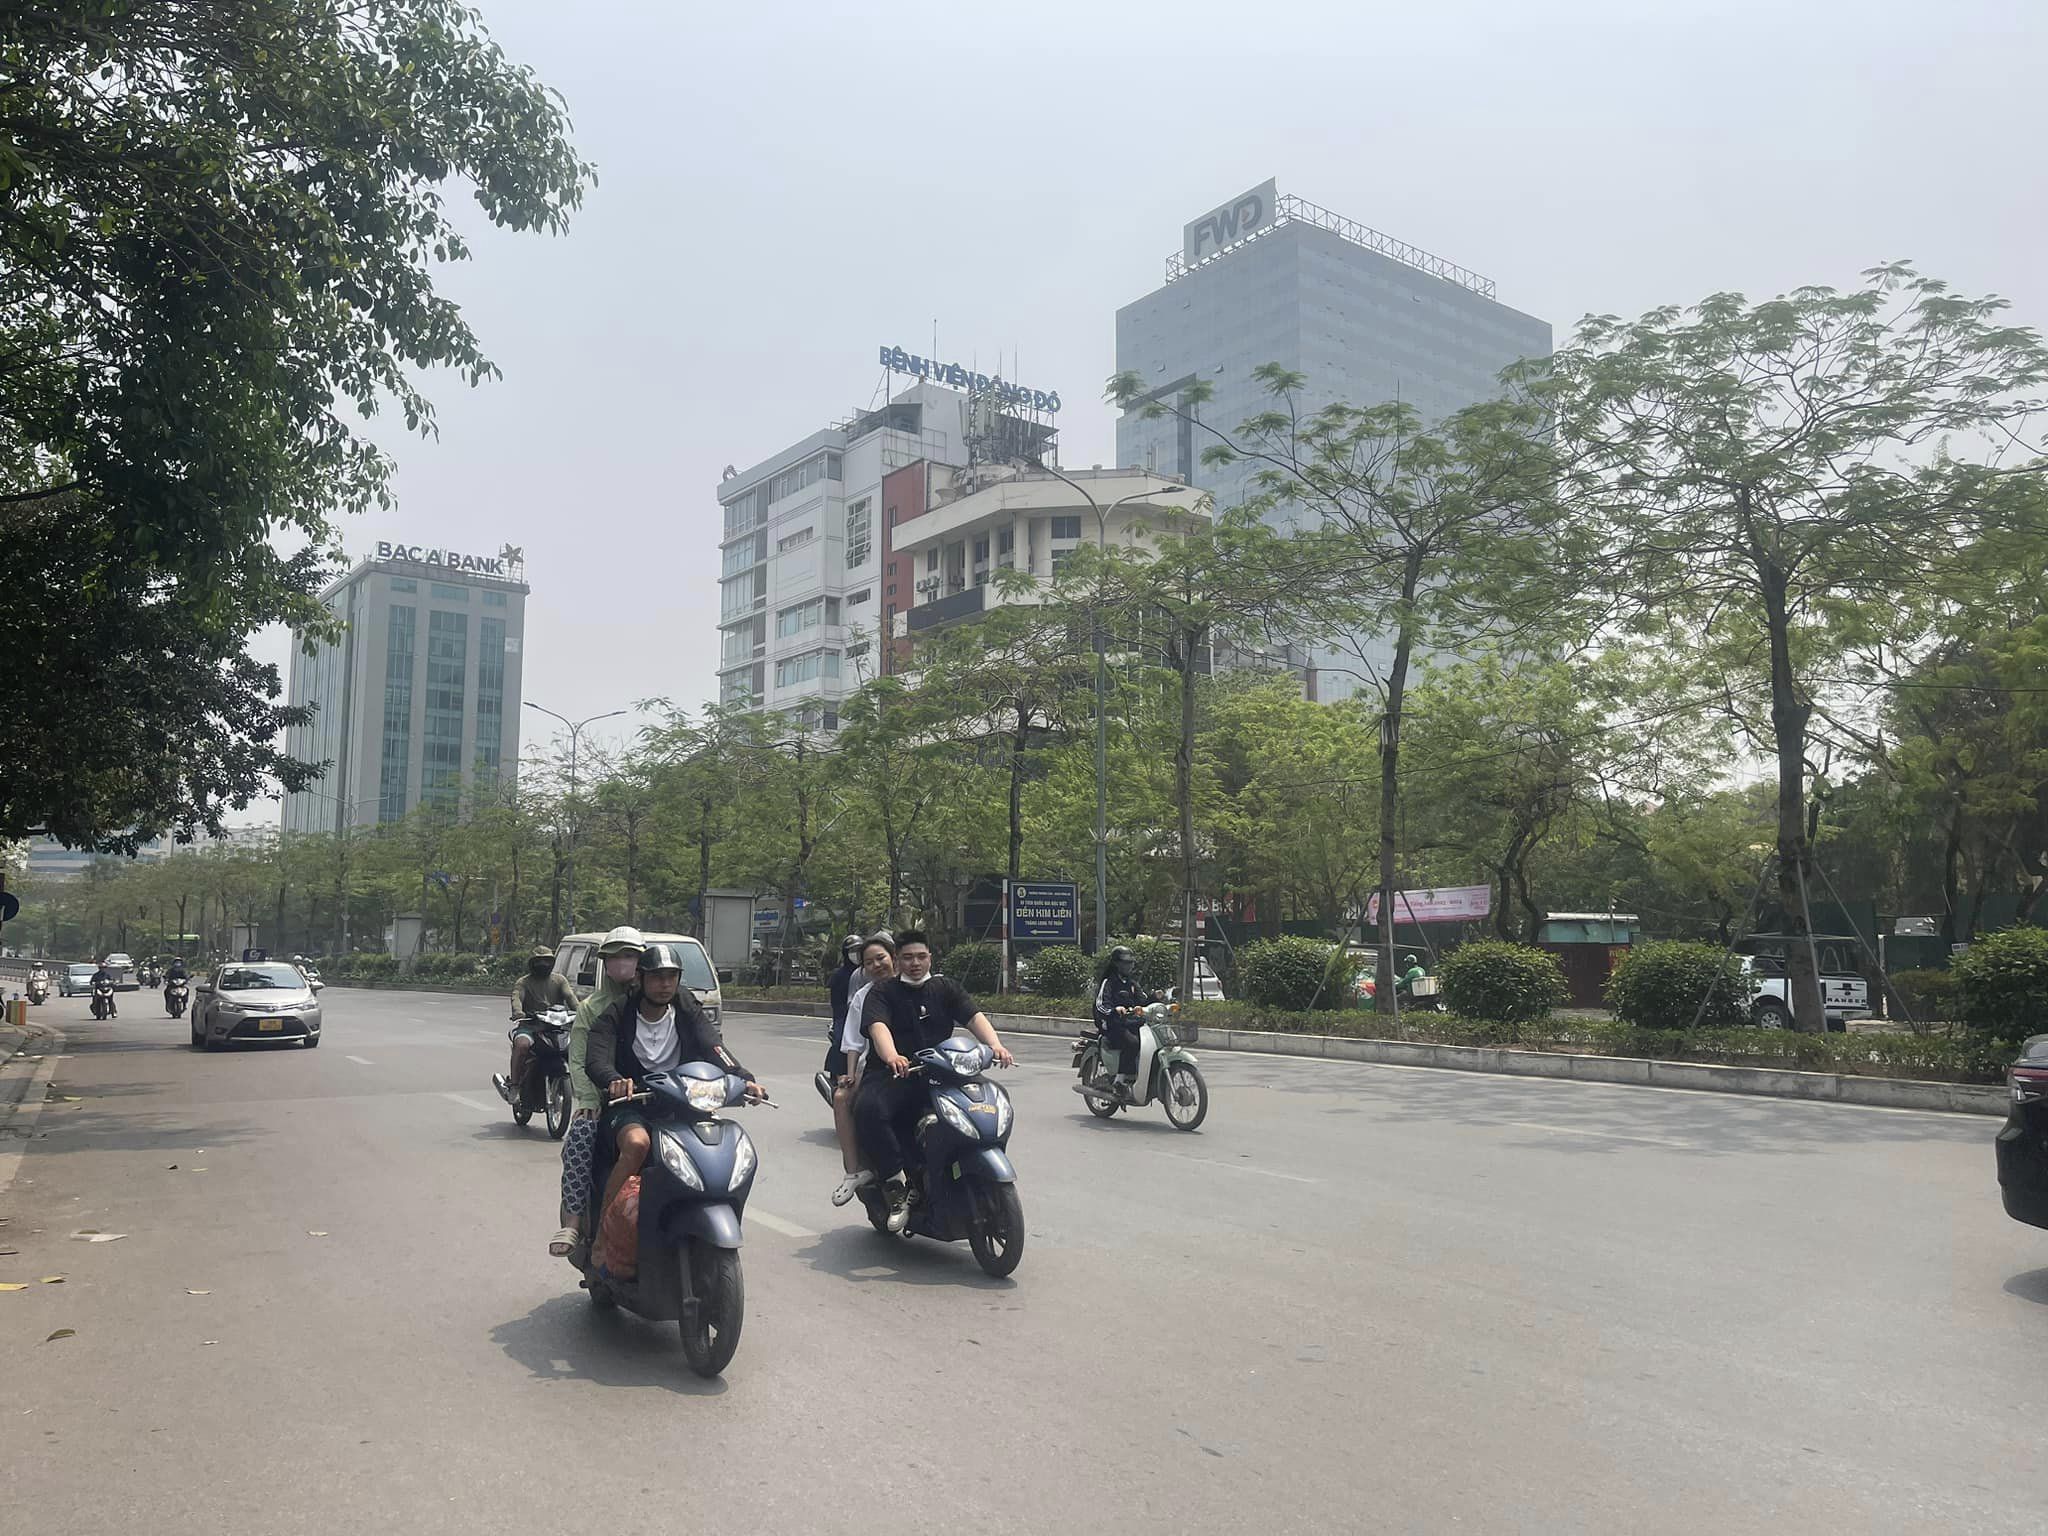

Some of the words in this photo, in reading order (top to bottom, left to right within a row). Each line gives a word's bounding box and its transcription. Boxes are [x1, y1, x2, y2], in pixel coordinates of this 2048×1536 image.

[1194, 195, 1262, 256] FWD
[879, 345, 929, 378] BỆNH
[932, 361, 975, 391] VIỆN
[1033, 390, 1062, 413] ĐÔ
[377, 541, 423, 562] BAC
[425, 549, 442, 567] A
[447, 552, 505, 575] BANK
[1036, 908, 1051, 918] KIM
[1052, 907, 1072, 918] LIÊN
